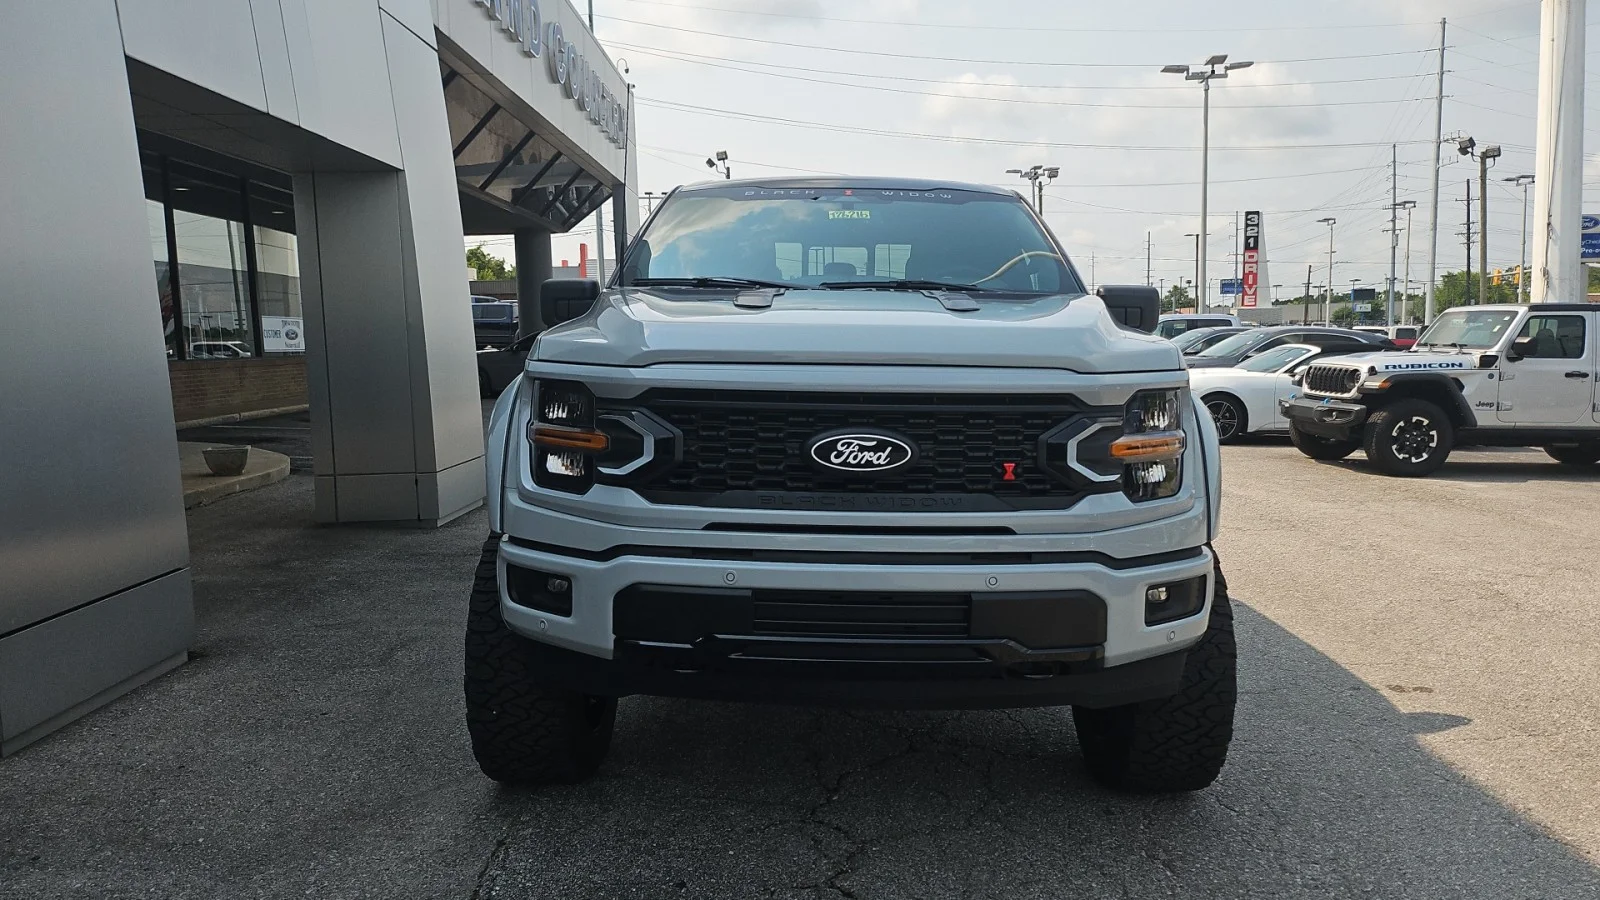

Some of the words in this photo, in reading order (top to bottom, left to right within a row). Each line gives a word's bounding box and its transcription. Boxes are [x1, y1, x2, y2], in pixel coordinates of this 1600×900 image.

[881, 191, 952, 199] WIDOW
[1246, 215, 1258, 247] 321
[1244, 252, 1257, 305] DRIVE
[1384, 362, 1463, 370] RUBICON
[830, 439, 892, 465] Ford
[758, 495, 856, 506] BLACK
[866, 496, 962, 507] WIDOW
